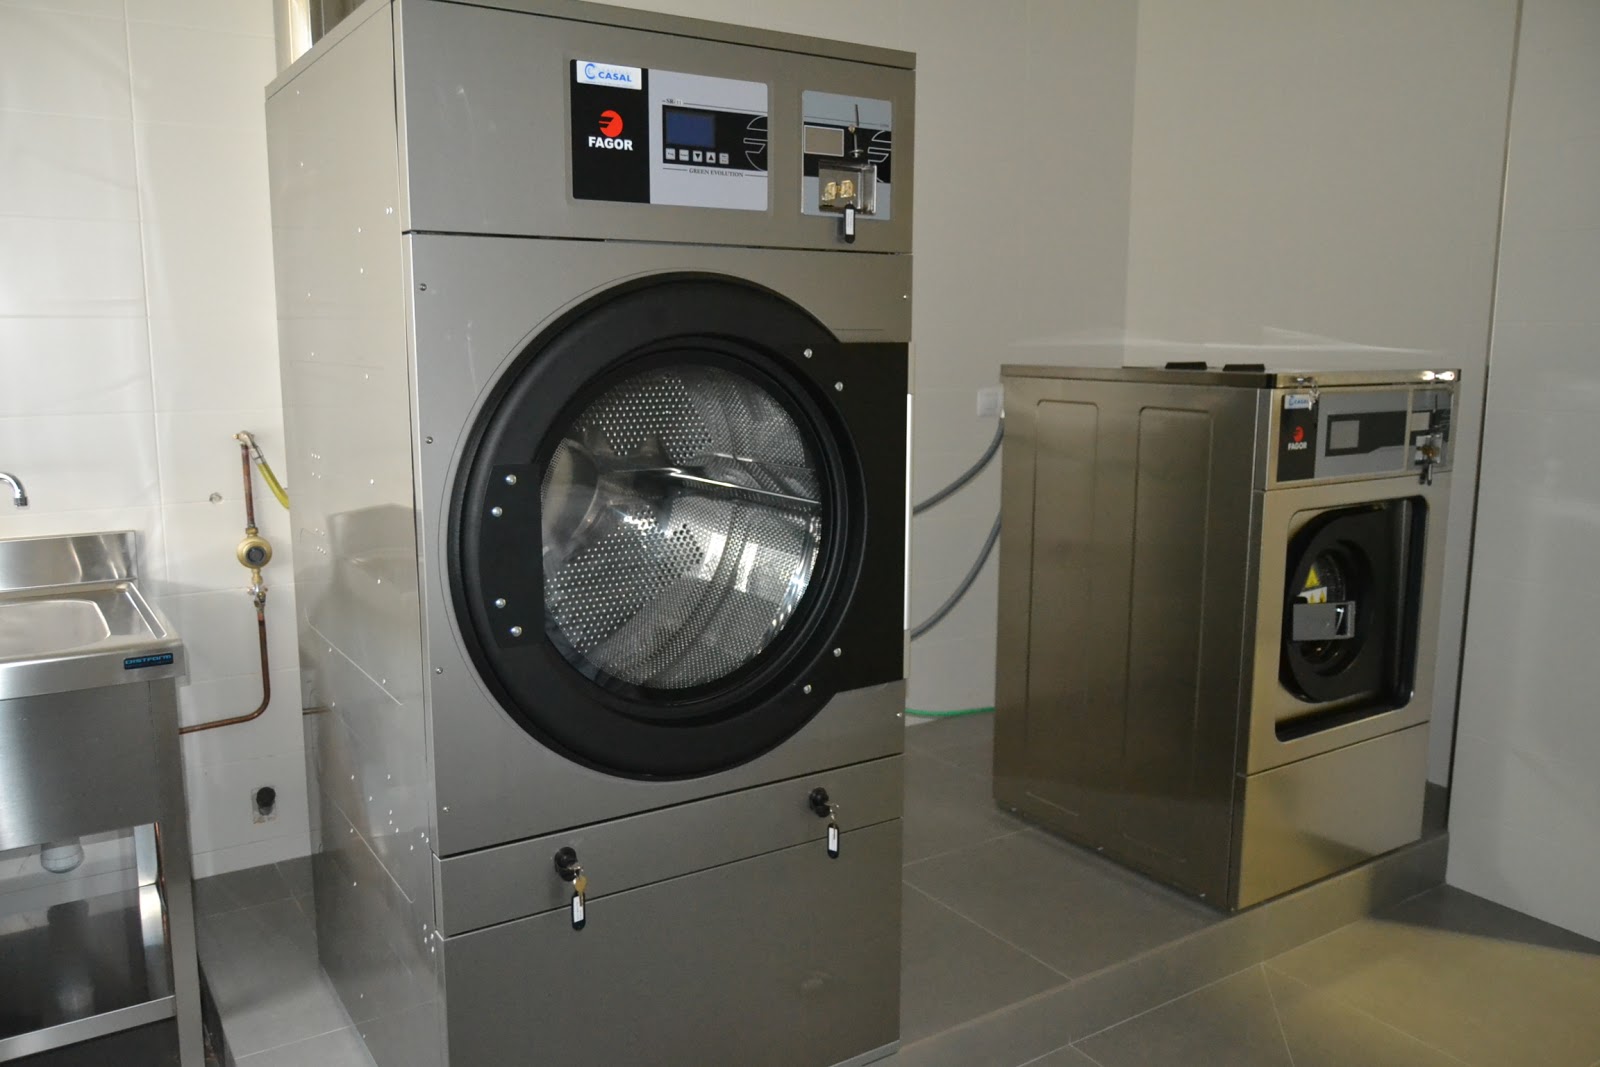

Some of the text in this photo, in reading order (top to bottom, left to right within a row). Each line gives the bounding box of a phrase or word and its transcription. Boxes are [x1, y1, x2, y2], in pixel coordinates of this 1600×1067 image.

[598, 71, 632, 82] CASAL
[588, 136, 633, 151] FAGOR
[710, 169, 744, 177] EVOLUTION
[1288, 442, 1307, 450] FAGOR
